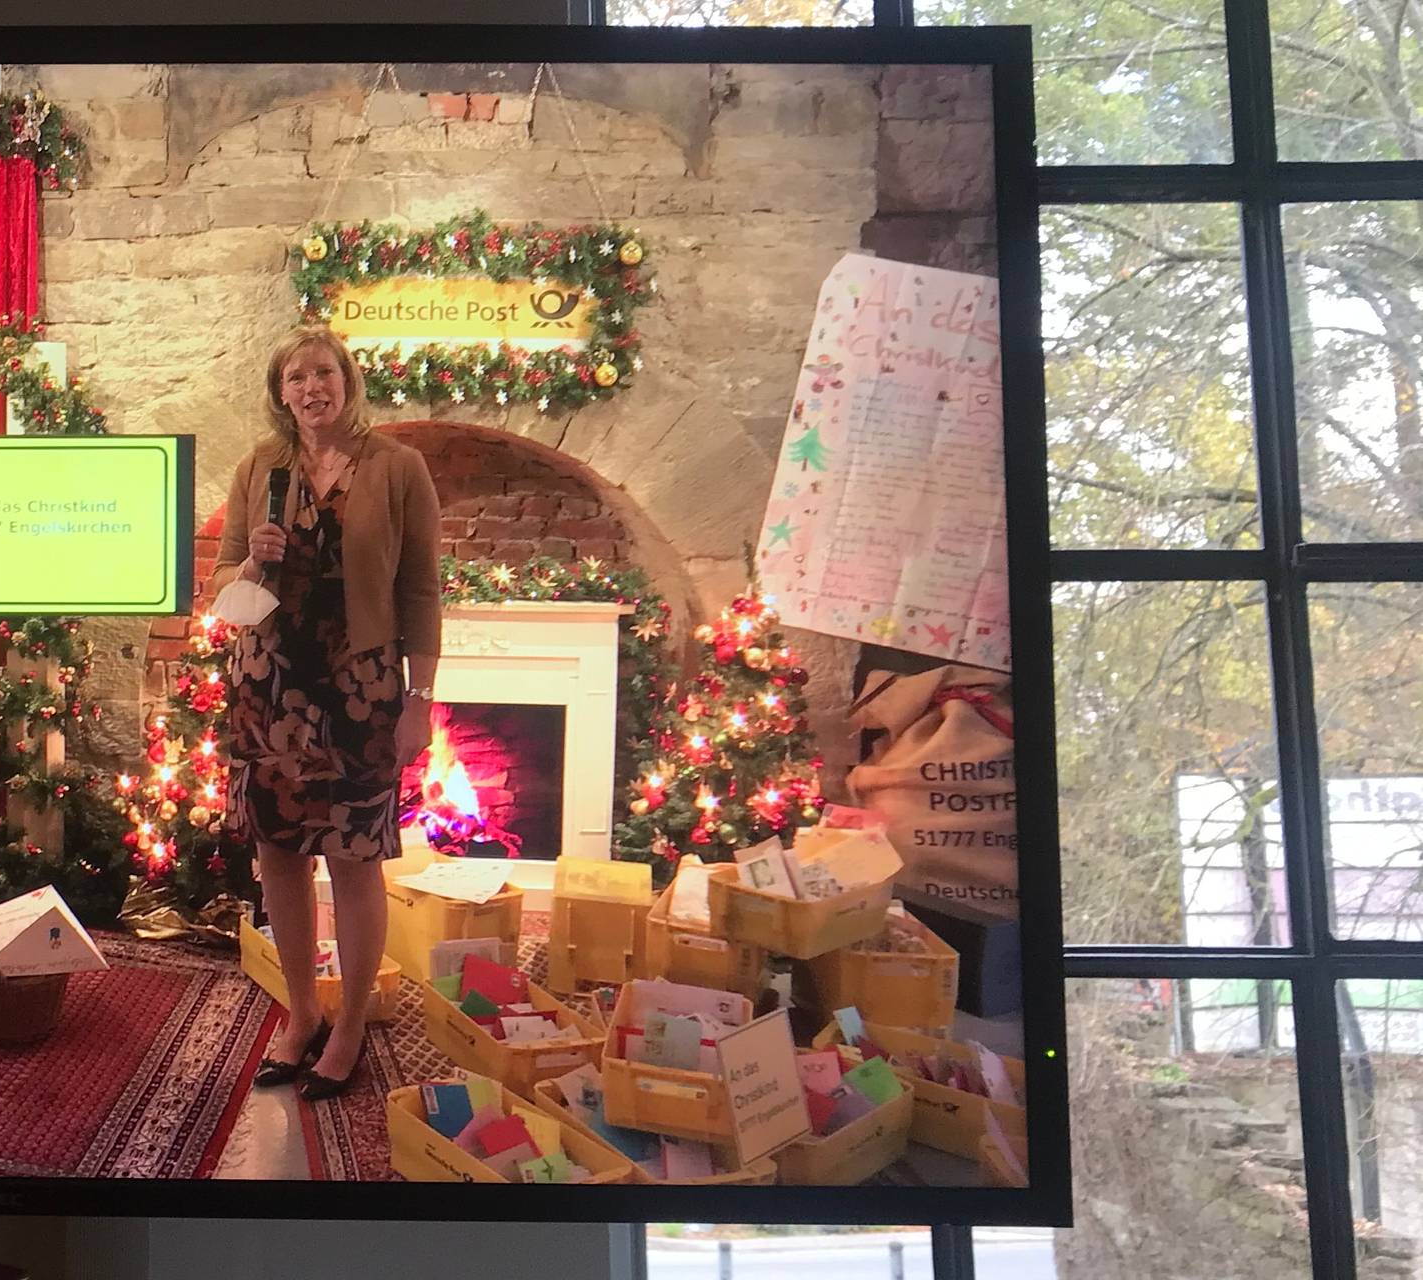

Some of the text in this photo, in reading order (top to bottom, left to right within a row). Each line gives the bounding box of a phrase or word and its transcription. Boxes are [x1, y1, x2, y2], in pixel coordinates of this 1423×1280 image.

[344, 299, 519, 322] Deutsche Post
[856, 272, 999, 345] An das
[27, 499, 117, 513] Christkind
[9, 521, 133, 537] Engelskirchen
[913, 829, 976, 847] 51777
